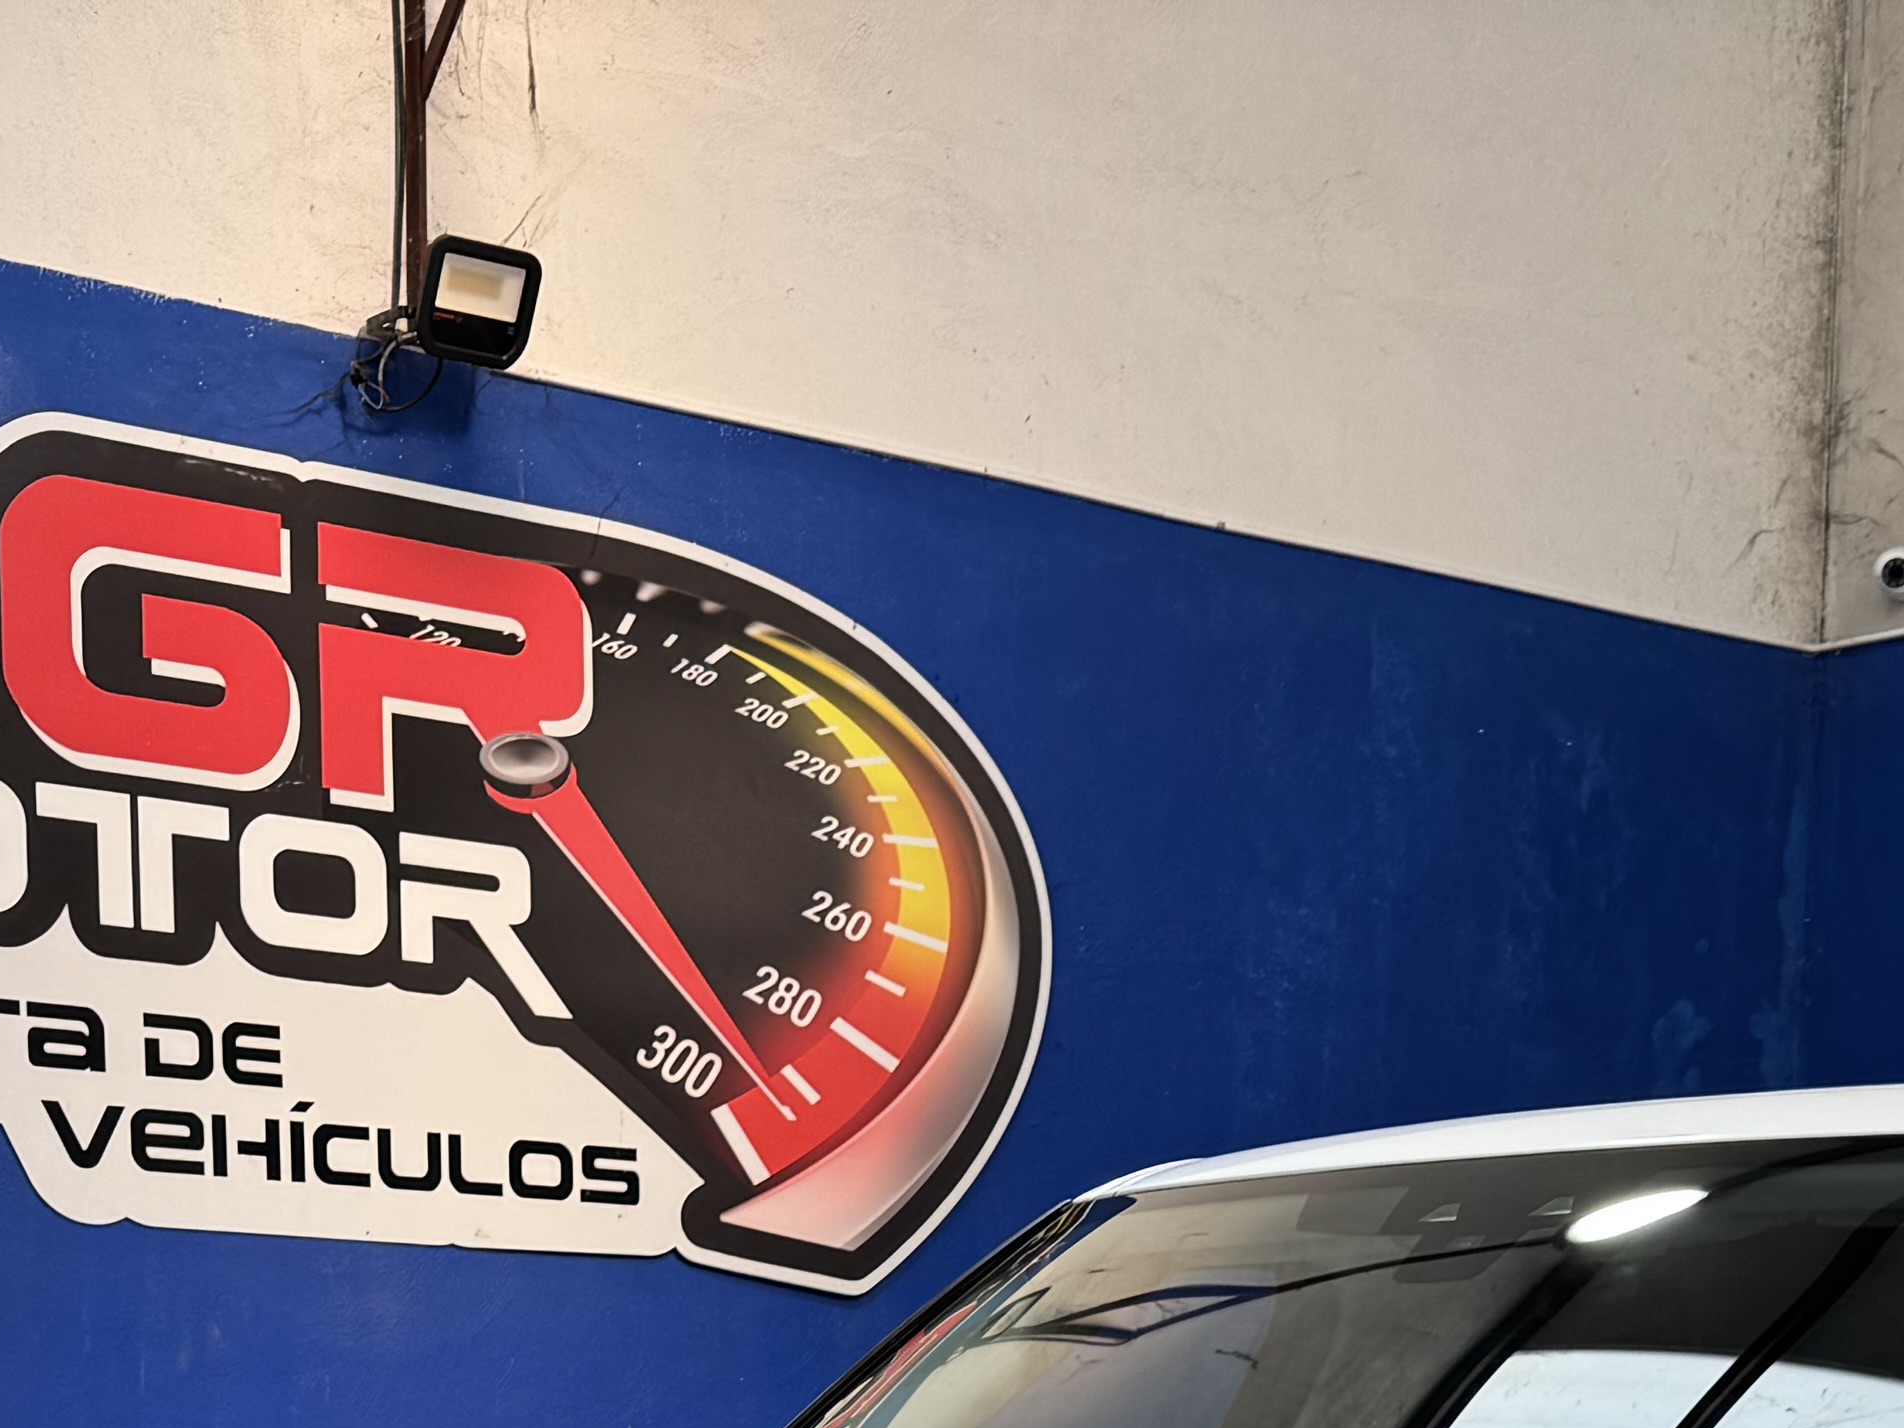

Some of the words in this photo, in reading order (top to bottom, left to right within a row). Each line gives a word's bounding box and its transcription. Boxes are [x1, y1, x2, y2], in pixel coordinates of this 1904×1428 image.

[592, 632, 638, 660] 160
[670, 658, 719, 687] 180
[734, 698, 789, 729] 200
[784, 749, 842, 786] 220
[810, 815, 875, 859] 240
[801, 890, 873, 942] 260
[742, 965, 823, 1028] 280
[143, 1012, 283, 1088] DE
[636, 1024, 723, 1098] 300
[41, 1099, 640, 1206] VEHÍCULOS
